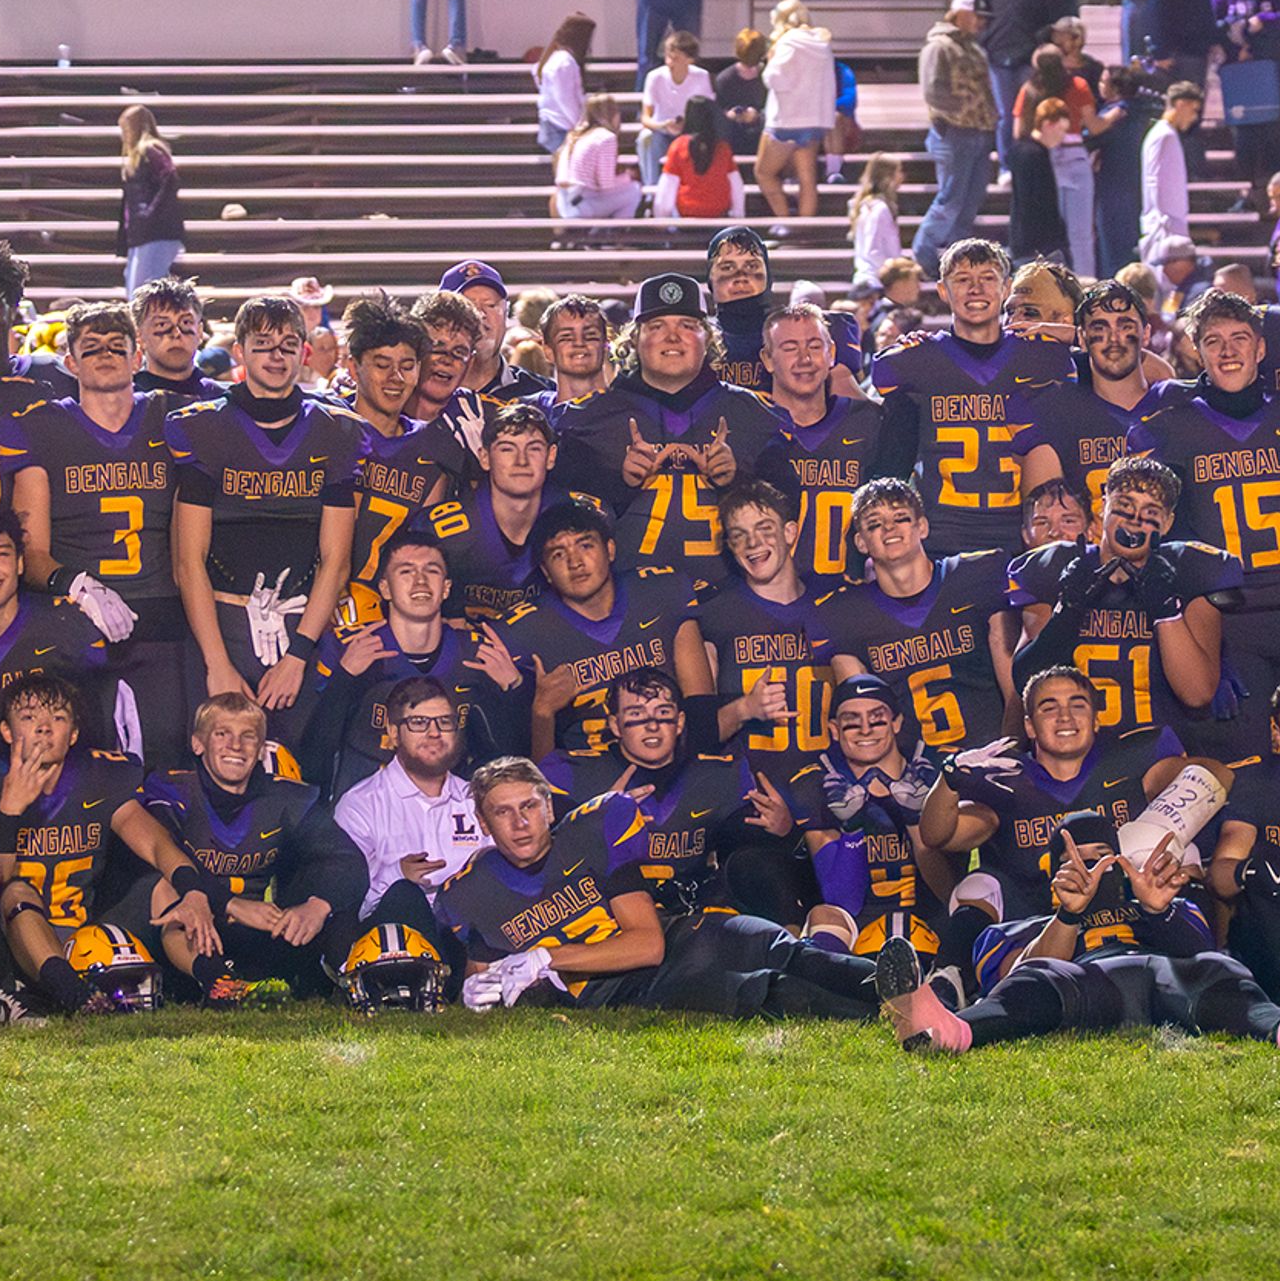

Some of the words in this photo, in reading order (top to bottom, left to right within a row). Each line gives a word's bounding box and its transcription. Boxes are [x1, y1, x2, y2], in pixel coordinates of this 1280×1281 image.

[930, 394, 1011, 423] BENGA
[65, 461, 168, 494] BENGALS
[222, 467, 325, 497] BENGALS
[356, 461, 427, 504] NGALS
[789, 459, 861, 488] NGALS
[935, 426, 1022, 508] 23
[637, 474, 722, 557] 75
[98, 495, 144, 576] 3
[1079, 609, 1154, 639] NGAL
[734, 633, 813, 662] BENGA
[868, 624, 975, 672] BENGALS
[741, 666, 831, 752] 50
[907, 664, 967, 747] 6
[15, 822, 102, 855] ENGALS
[452, 813, 476, 835] L
[647, 827, 705, 860] GALS
[500, 875, 603, 948] BENGALS
